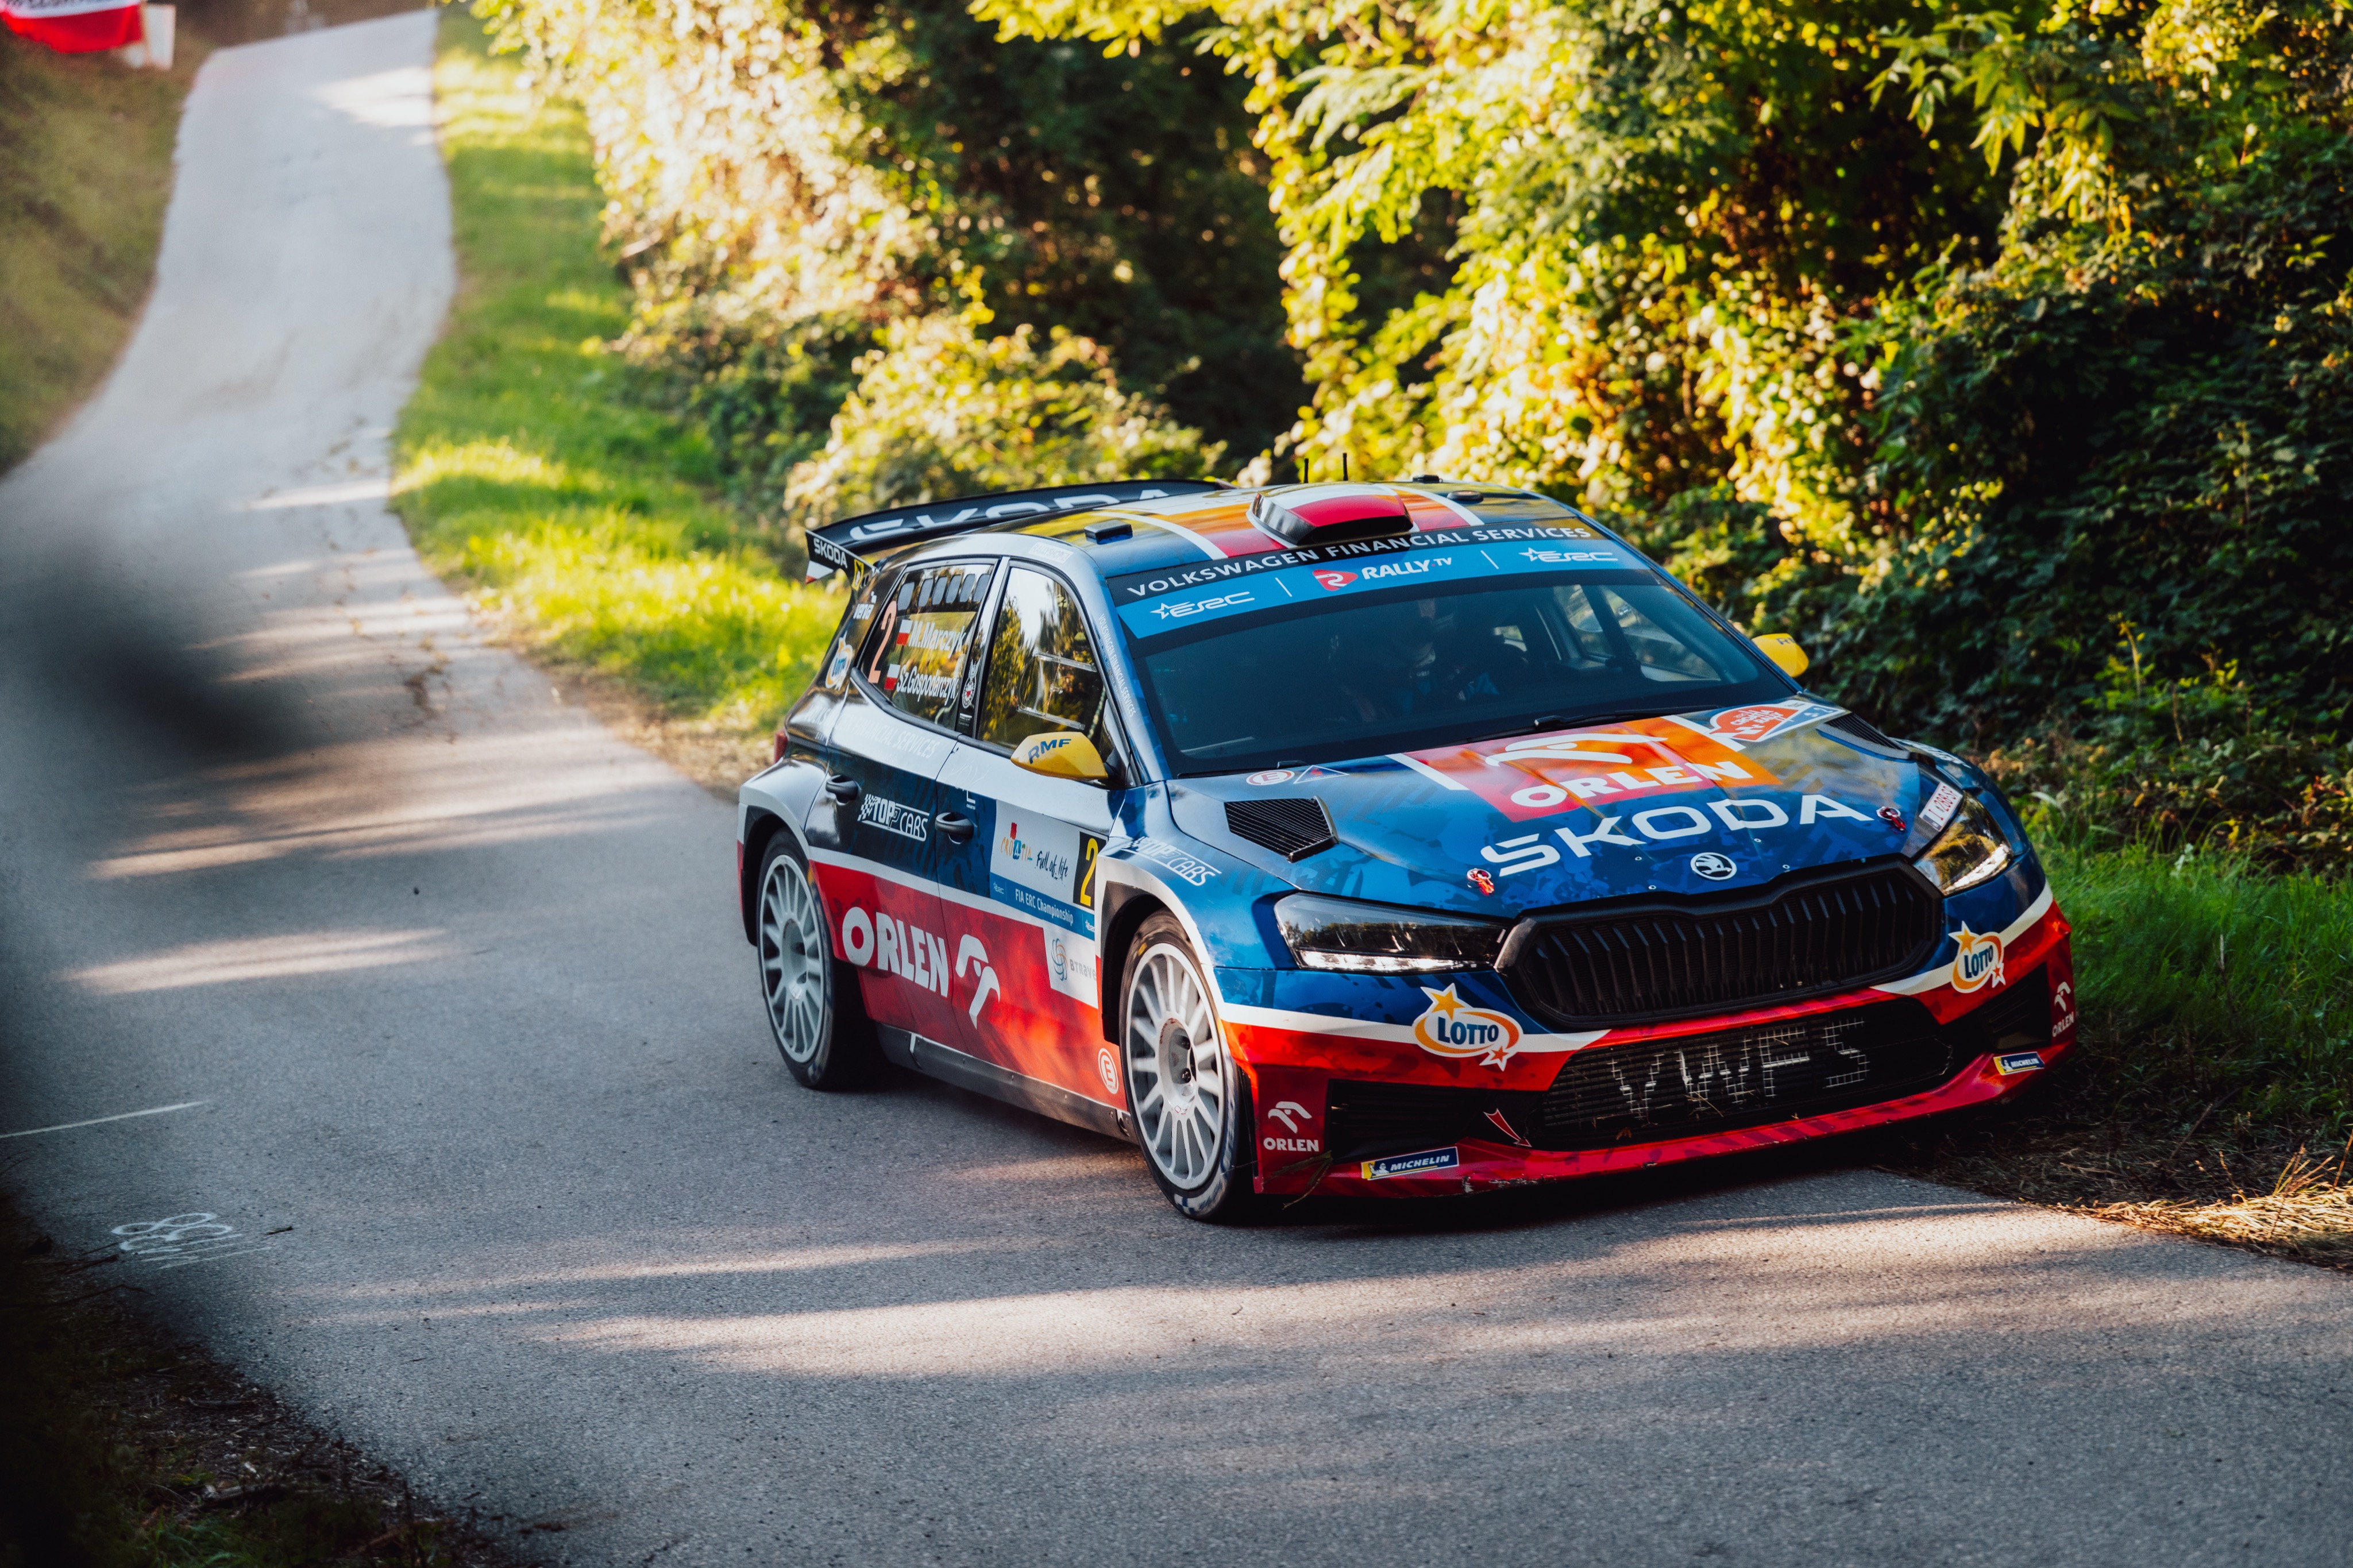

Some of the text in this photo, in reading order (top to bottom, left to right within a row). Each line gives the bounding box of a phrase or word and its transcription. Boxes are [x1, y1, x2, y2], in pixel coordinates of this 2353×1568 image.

[813, 538, 847, 569] SKODA
[1127, 527, 1591, 597] VOLKSWAGEN FINANCIAL SERVICES
[868, 600, 897, 683] 2
[909, 620, 967, 658] M.Marczyk
[1098, 613, 1116, 656] VOLKSWAGEN
[1111, 654, 1125, 689] FINANCIAL
[1121, 686, 1136, 717] SERVICES
[897, 665, 959, 706] Sz.Gospodarczyk
[892, 729, 941, 759] SERVICES
[1028, 739, 1071, 764] RMF
[1262, 773, 1279, 781] E
[1510, 761, 1753, 808] ORLEN
[900, 812, 928, 841] CARS
[1480, 794, 1874, 876] SKODA
[1000, 837, 1068, 881] CROATIA Full of life
[1080, 837, 1098, 907] 2
[1167, 857, 1216, 886] CARS
[1015, 889, 1025, 904] FIA
[1025, 893, 1036, 908] ERC
[1037, 898, 1073, 926] Championship
[842, 907, 949, 998] ORLEN
[1964, 945, 1993, 979] LOTTO
[1437, 1016, 1499, 1045] LOTTO
[2052, 1011, 2074, 1037] ORLEN
[1104, 1059, 1113, 1083] E
[2010, 1058, 2039, 1068] MICHELIN
[1263, 1137, 1319, 1152] ORLEN
[1390, 1154, 1450, 1172] MICHELIN
